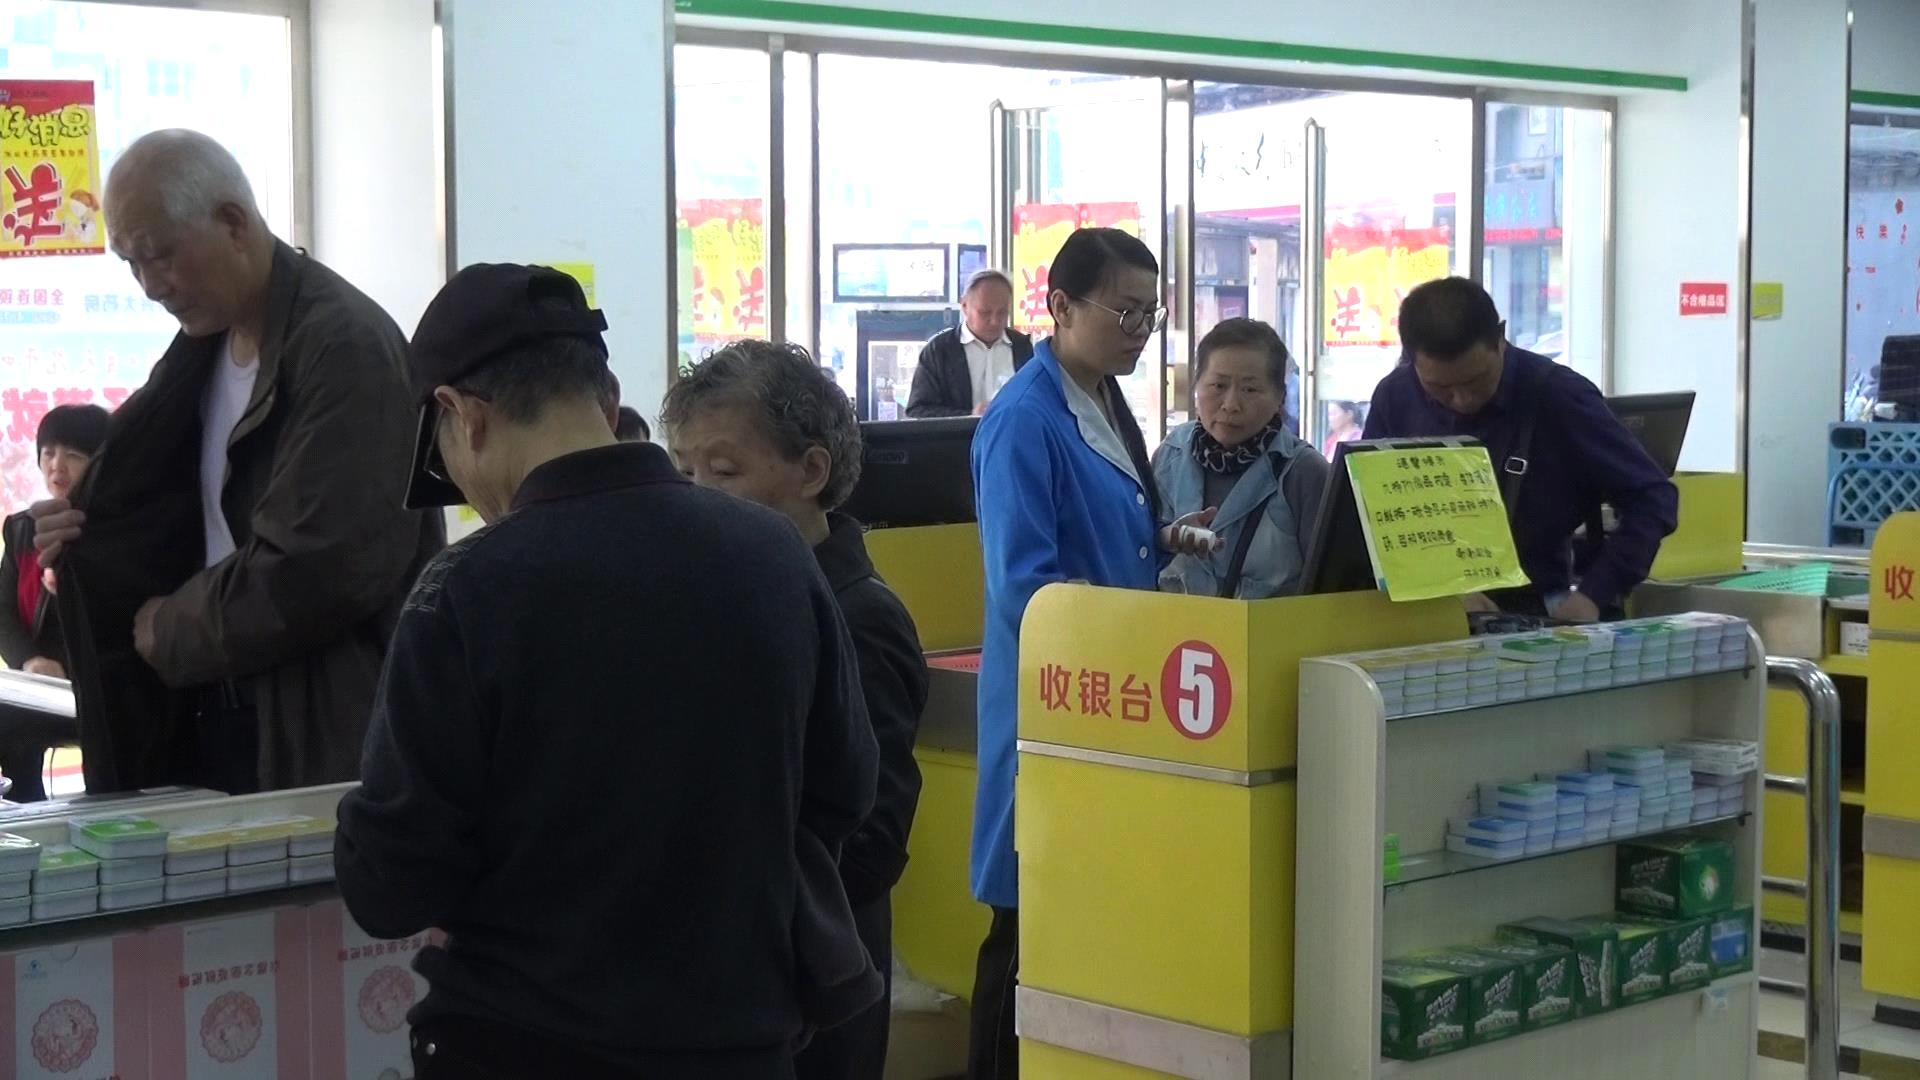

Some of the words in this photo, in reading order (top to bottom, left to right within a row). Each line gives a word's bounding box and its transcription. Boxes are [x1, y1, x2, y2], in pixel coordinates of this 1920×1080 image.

[3, 163, 64, 246] 送
[1885, 565, 1915, 601] 收
[1040, 664, 1152, 722] 收银台
[1178, 648, 1215, 734] 5
